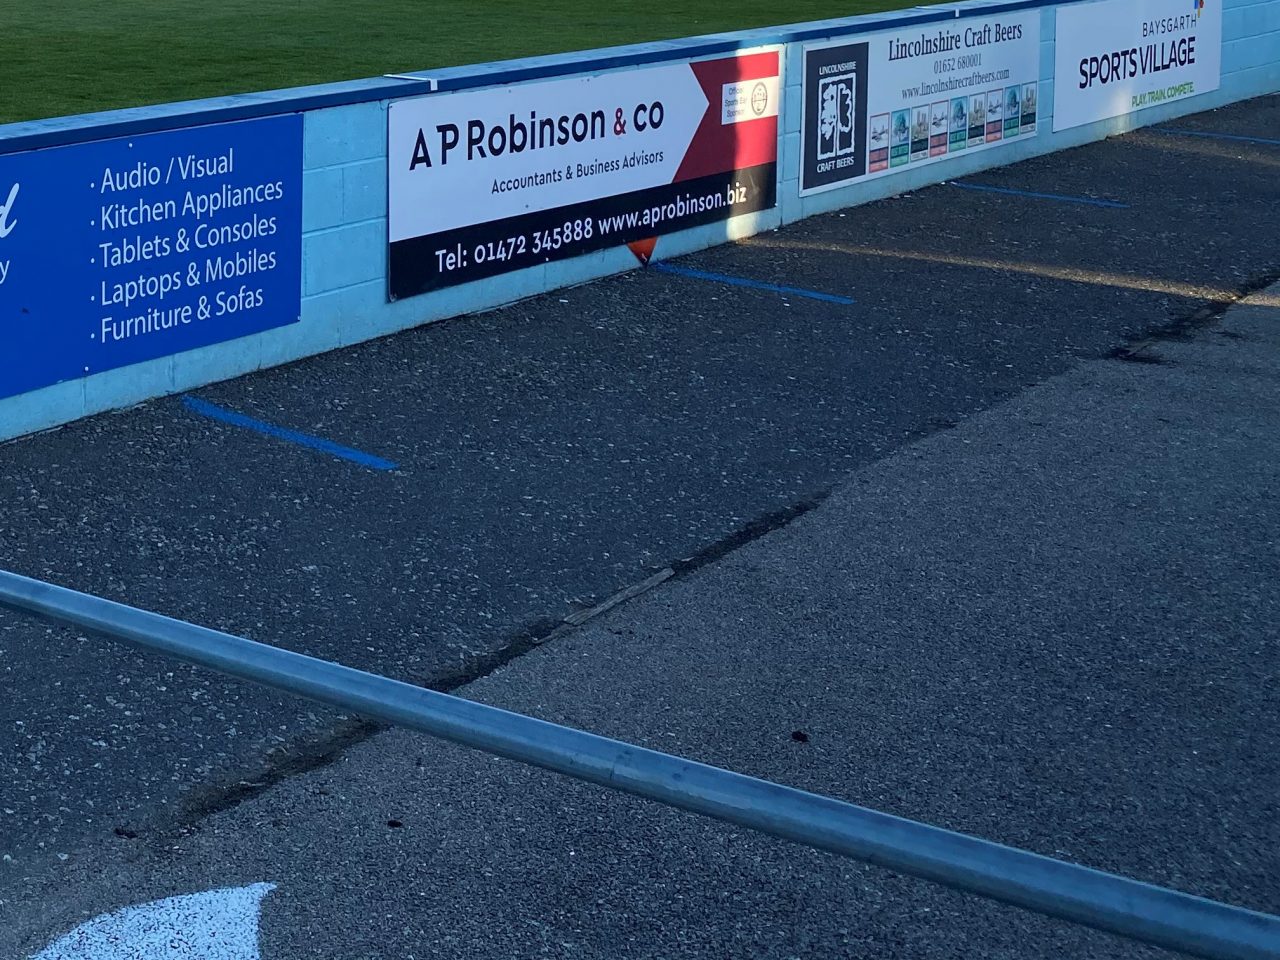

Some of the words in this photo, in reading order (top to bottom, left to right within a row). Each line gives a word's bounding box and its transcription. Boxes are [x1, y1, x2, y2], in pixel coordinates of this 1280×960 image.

[888, 30, 961, 61] Lincolnshire
[964, 23, 991, 46] Craft
[994, 23, 1023, 43] Beers
[1142, 14, 1197, 37] BAYSGARTH
[818, 61, 857, 75] LINCOLNSHIRE
[902, 68, 1010, 100] www.lincolnshirecraftbeers.com
[933, 57, 955, 74] 01652
[957, 53, 982, 71] 680001
[613, 107, 626, 136] &
[633, 100, 664, 133] co
[100, 161, 161, 194] Audio
[177, 147, 234, 181] Visual
[491, 169, 562, 195] Accountants
[566, 165, 574, 180] &
[576, 158, 620, 179] Business
[622, 149, 664, 170] Advisors
[816, 160, 835, 173] CRAFT
[836, 157, 855, 169] BEERS
[101, 198, 176, 231] Kitchen
[181, 180, 284, 220] Appliances
[99, 234, 171, 268] Tablets
[175, 227, 190, 253] &
[194, 213, 278, 250] Consoles
[435, 247, 468, 273] Tel:
[474, 235, 526, 264] 01472
[532, 216, 593, 255] 345888
[598, 184, 747, 235] www.aprobinson.biz
[101, 270, 182, 307] Laptops
[185, 261, 201, 287] &
[205, 247, 277, 282] Mobiles
[101, 303, 192, 343] Furniture
[196, 295, 211, 320] &
[215, 284, 264, 317] Sofas
